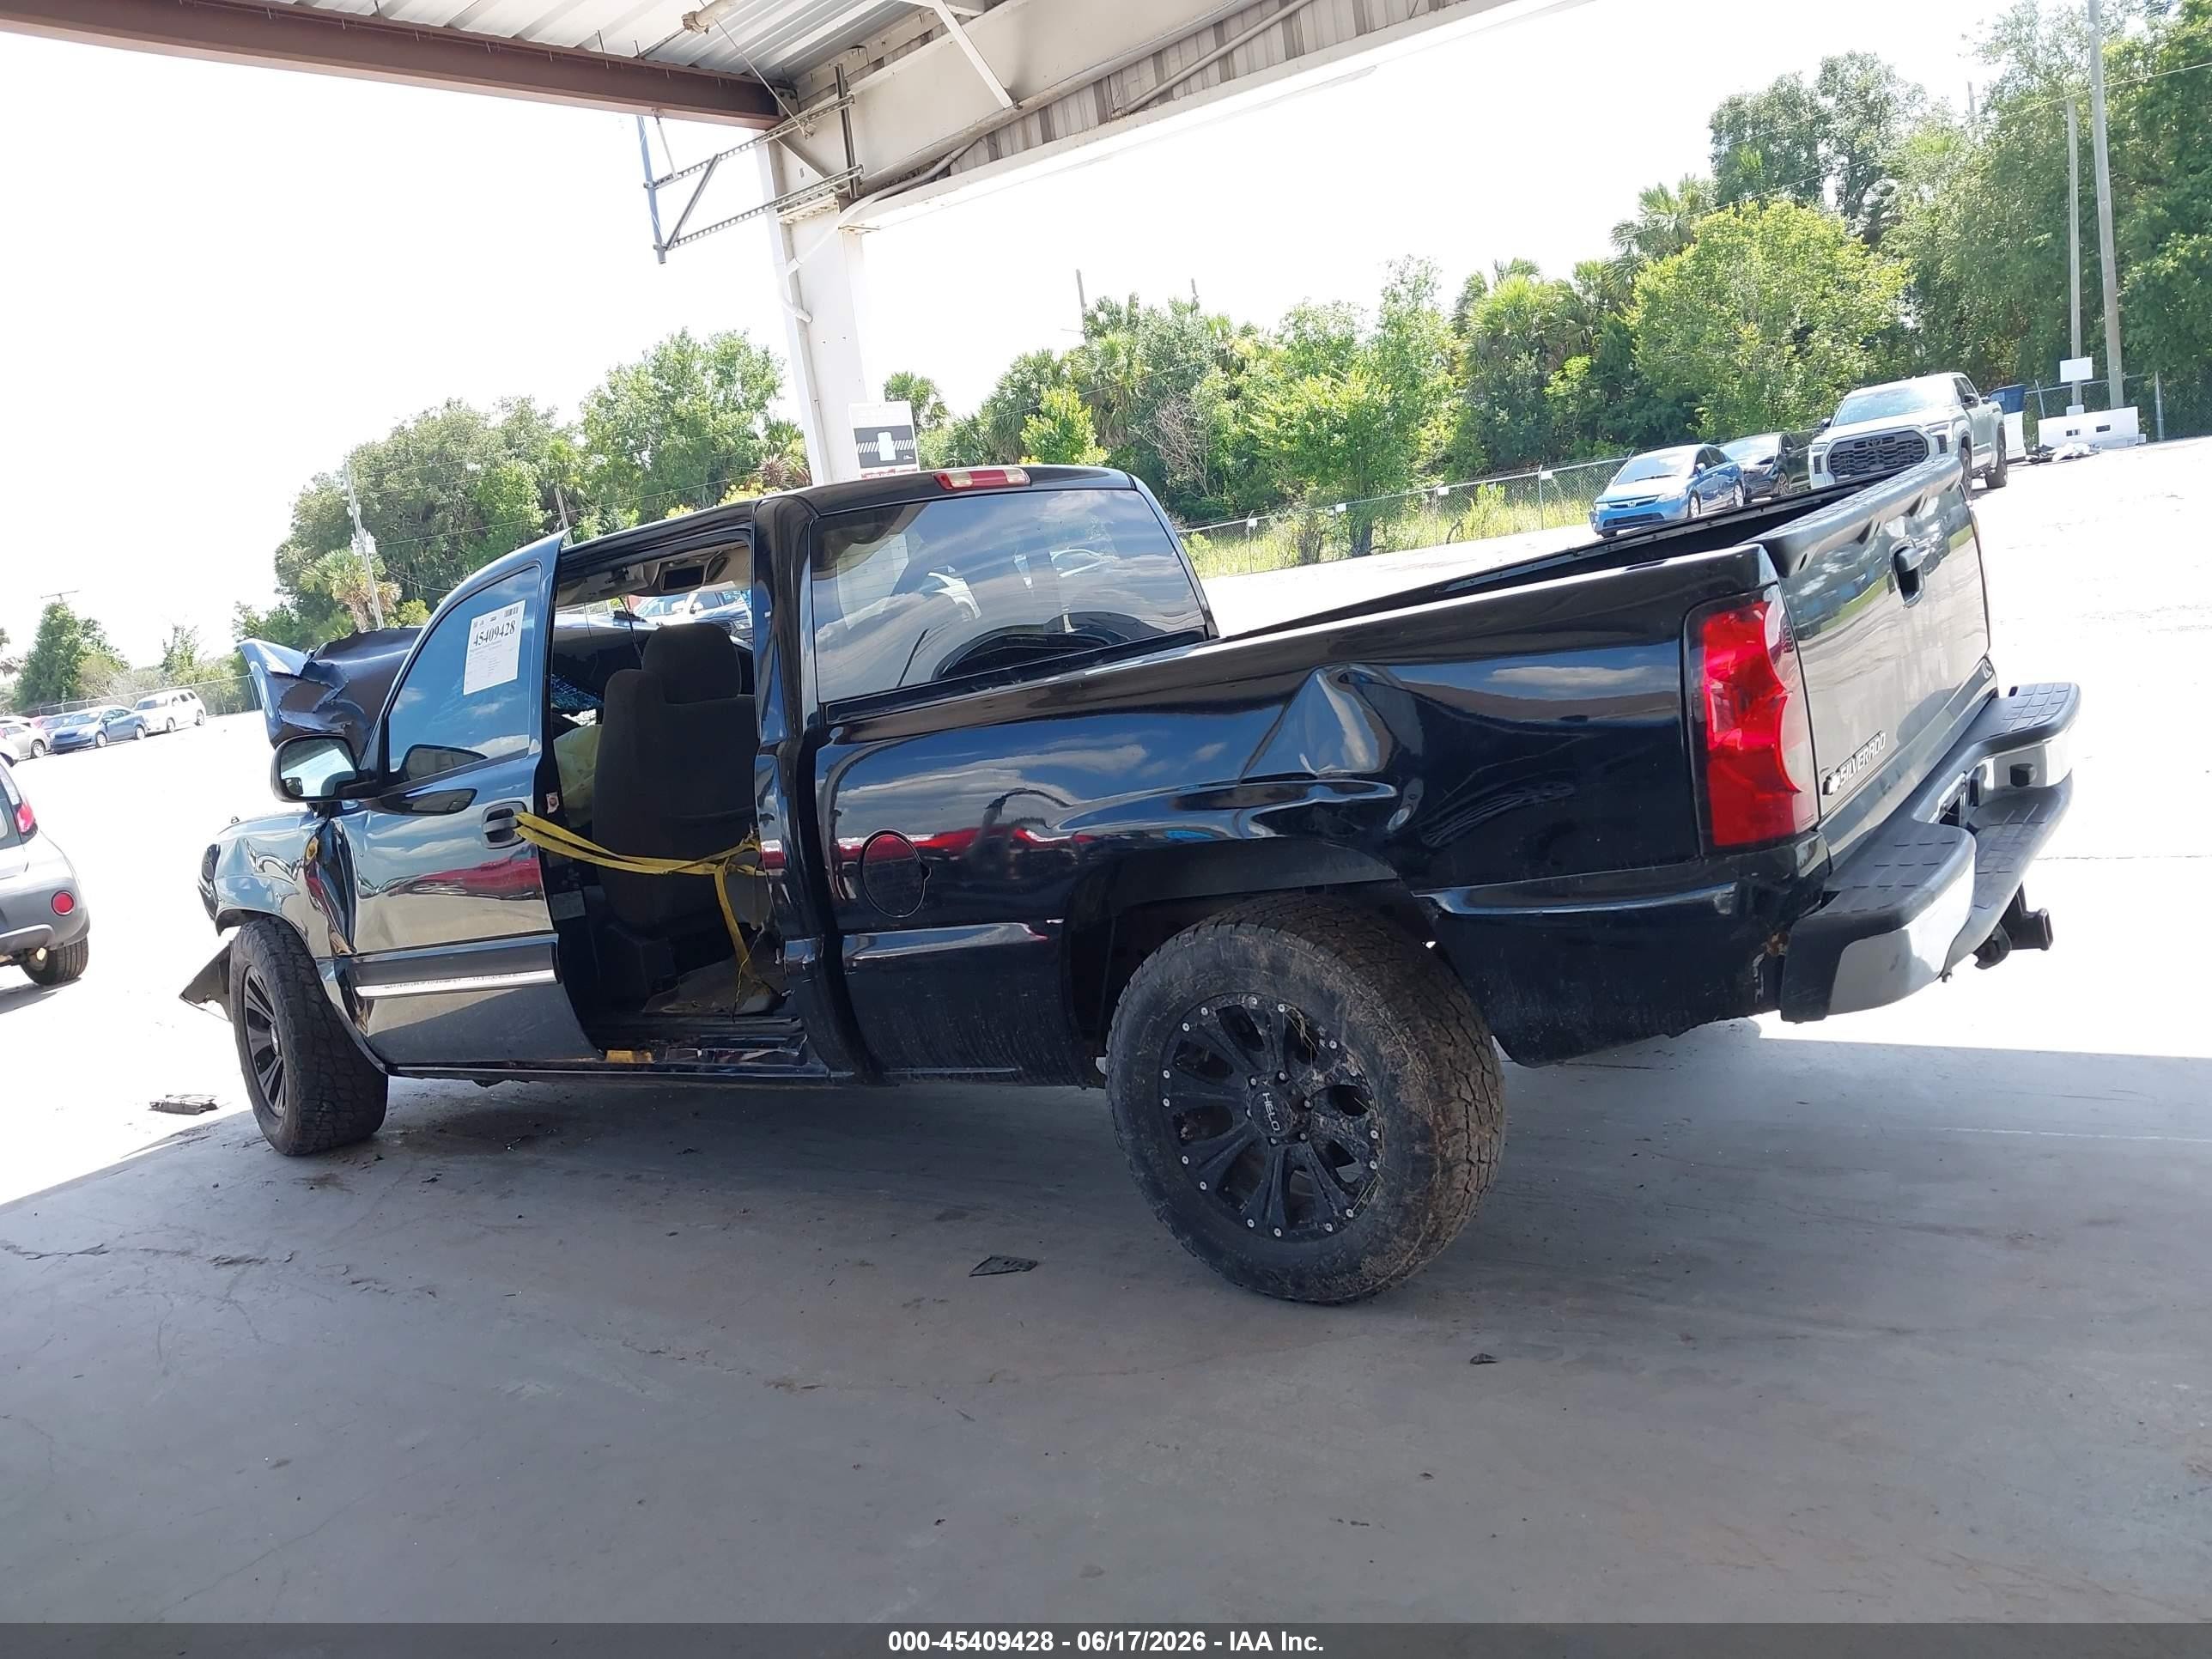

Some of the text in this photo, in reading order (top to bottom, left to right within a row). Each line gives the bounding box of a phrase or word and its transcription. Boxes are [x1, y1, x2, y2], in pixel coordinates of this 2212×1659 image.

[473, 619, 516, 647] 45409428
[1838, 732, 1887, 786] SILVERADO
[1262, 1092, 1280, 1131] HELO
